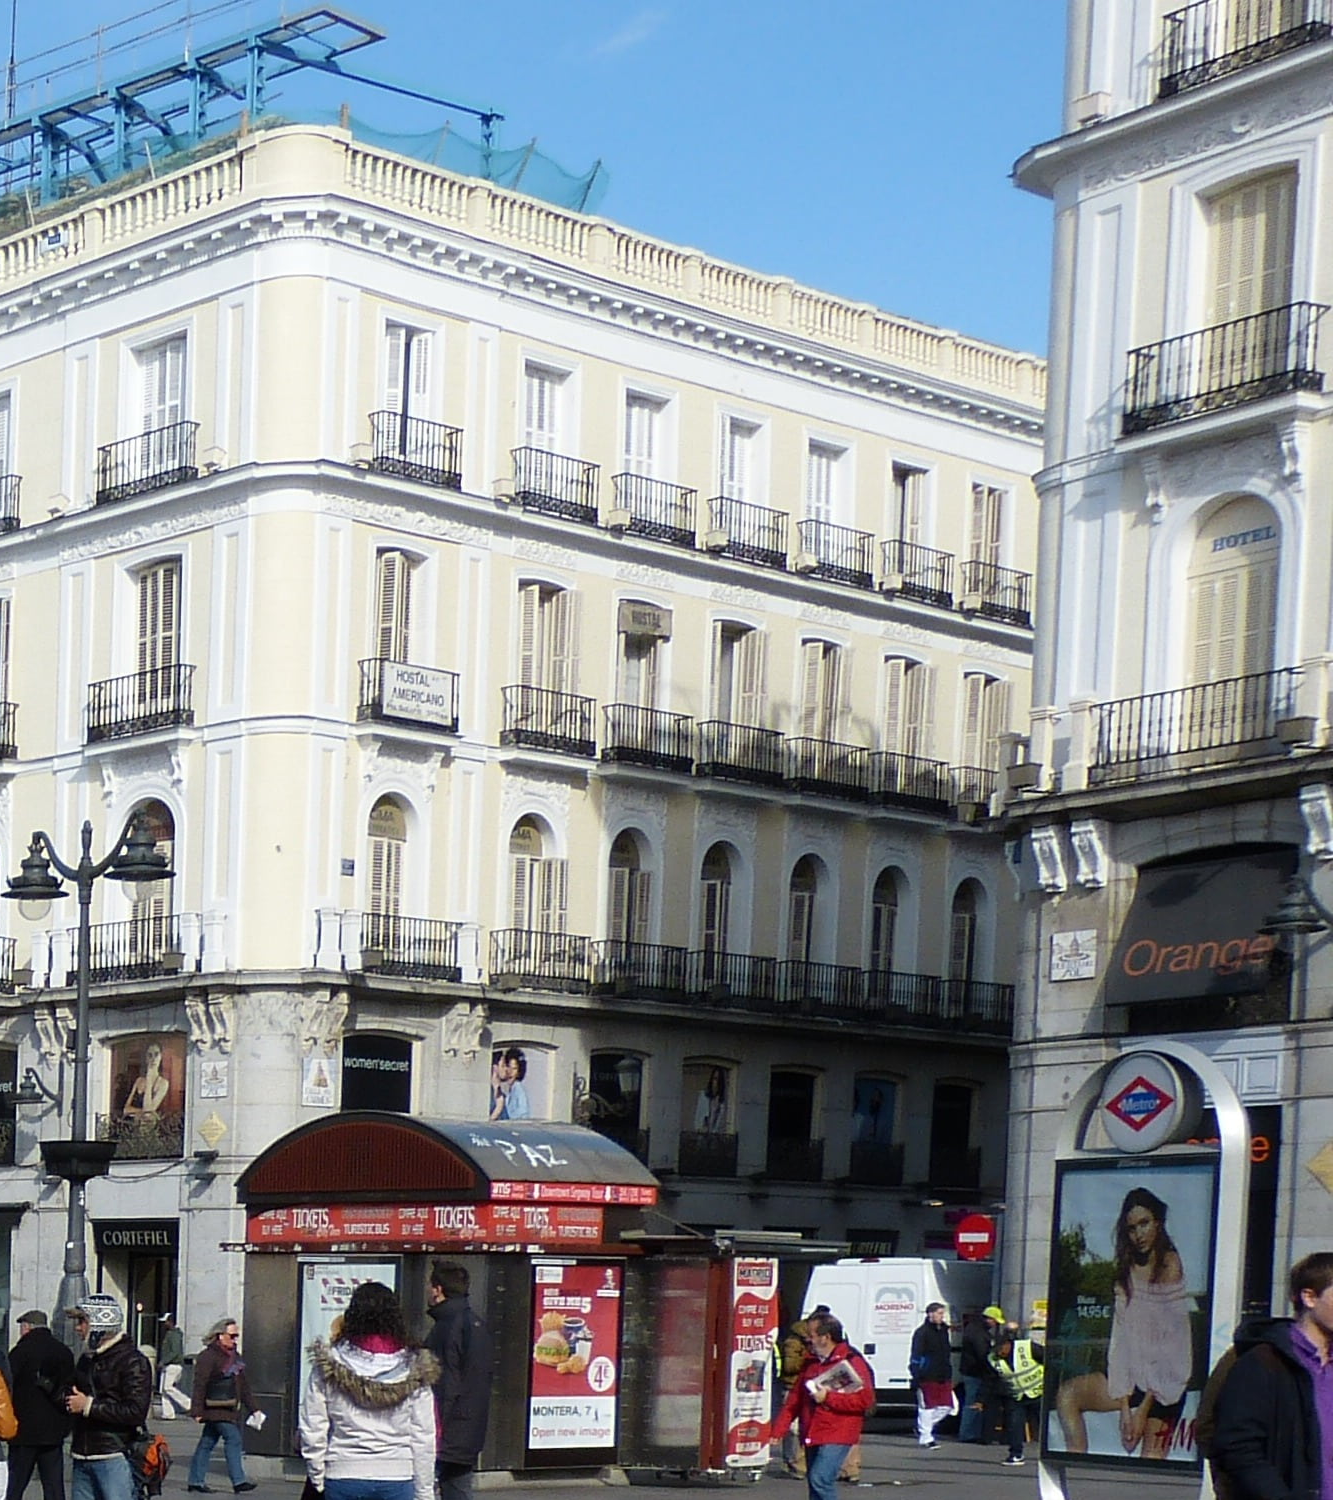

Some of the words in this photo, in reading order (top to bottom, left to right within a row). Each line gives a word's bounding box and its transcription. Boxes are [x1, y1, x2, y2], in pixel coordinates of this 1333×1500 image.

[1212, 526, 1276, 552] HOTEL
[395, 669, 430, 687] HOSTAL
[393, 687, 445, 707] AMERICANO
[1123, 936, 1274, 976] Orange
[343, 1056, 409, 1072] women'secret
[1122, 1094, 1157, 1111] Metro
[494, 1139, 569, 1168] PAZ
[292, 1208, 330, 1228] TICKETS
[433, 1206, 476, 1228] TICKETS
[101, 1230, 173, 1247] CORTEFIEL
[533, 1406, 581, 1417] MONTERA,
[532, 1427, 555, 1438] Open
[579, 1426, 611, 1438] image
